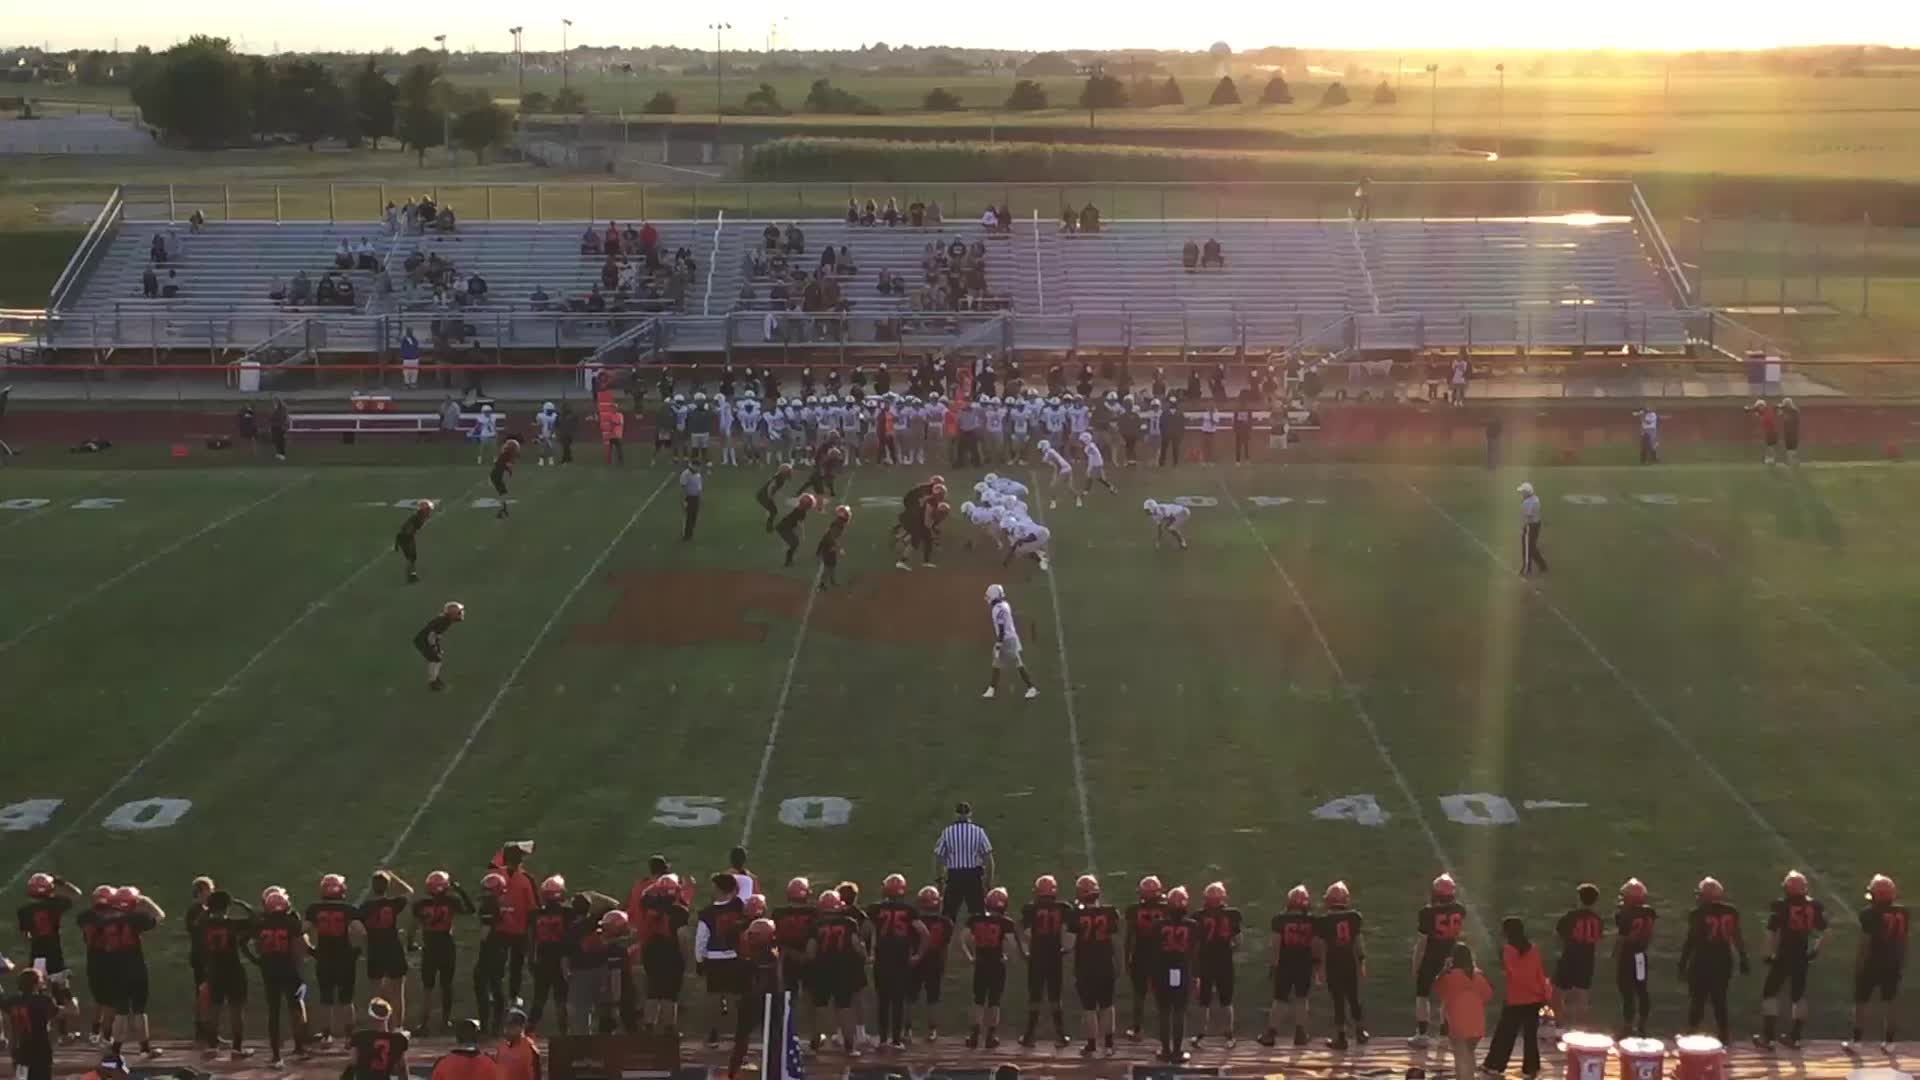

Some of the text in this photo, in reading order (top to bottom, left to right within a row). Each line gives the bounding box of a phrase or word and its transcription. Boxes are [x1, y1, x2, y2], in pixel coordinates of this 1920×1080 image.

[651, 795, 853, 828] 50
[1310, 793, 1520, 826] 40
[879, 910, 908, 937] 75
